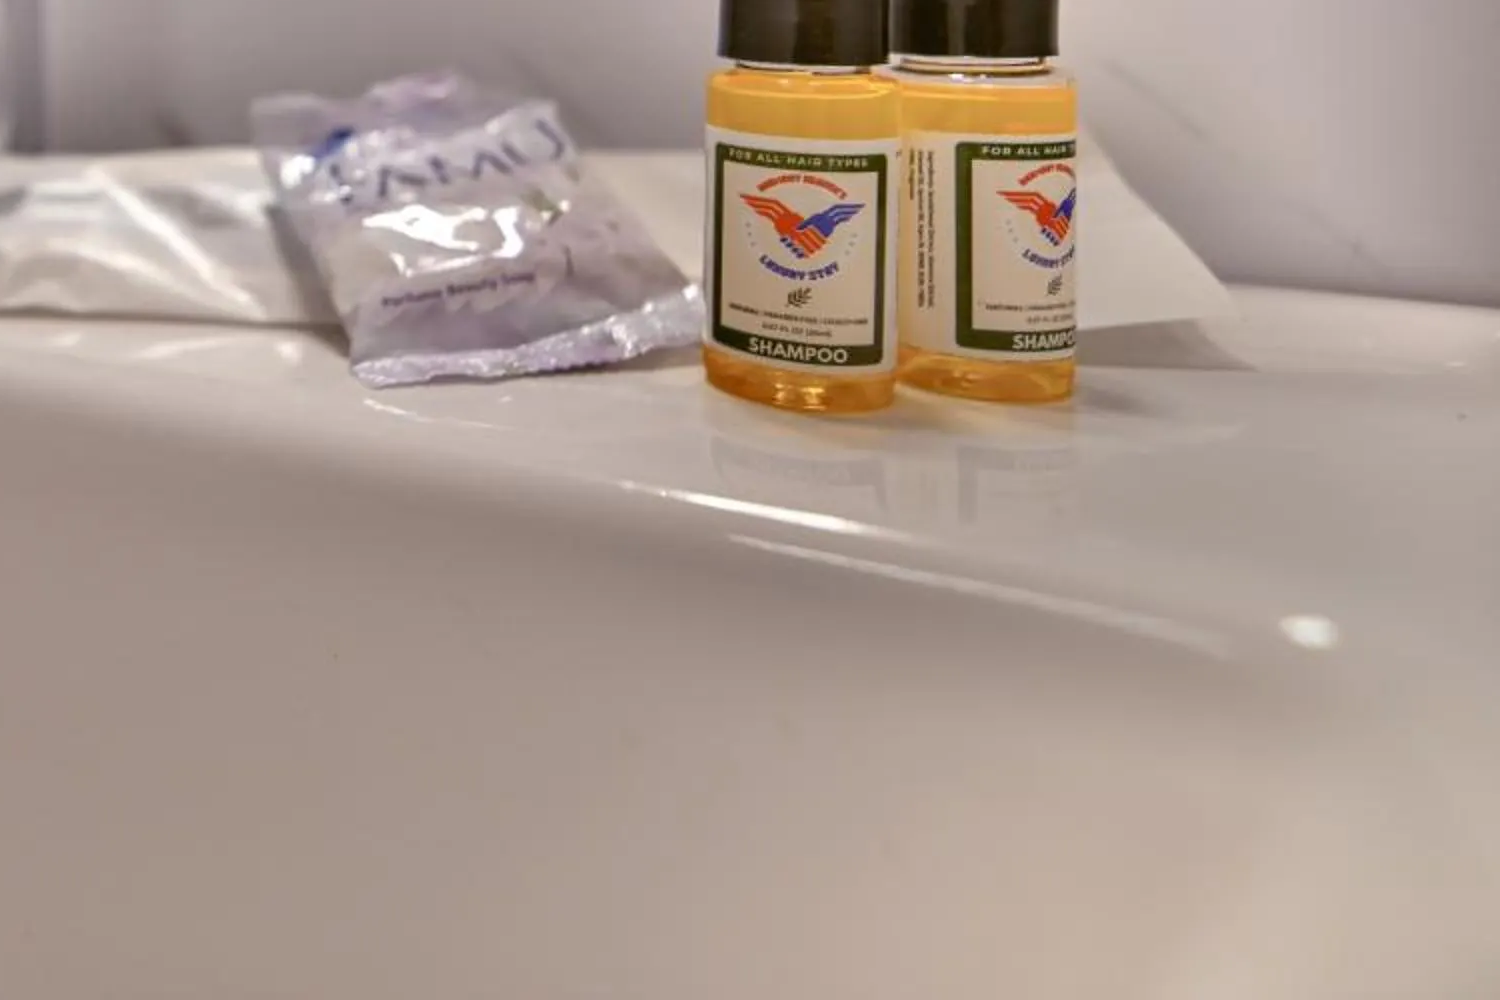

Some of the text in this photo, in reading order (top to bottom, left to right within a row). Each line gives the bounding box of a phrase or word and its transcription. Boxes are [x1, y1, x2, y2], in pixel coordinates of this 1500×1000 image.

[729, 148, 869, 169] FOR ALL HAIR TYPES
[981, 145, 1011, 156] FOR
[1017, 145, 1040, 155] ALL
[1043, 145, 1067, 155] HAIR
[748, 336, 850, 363] SHAMPOO
